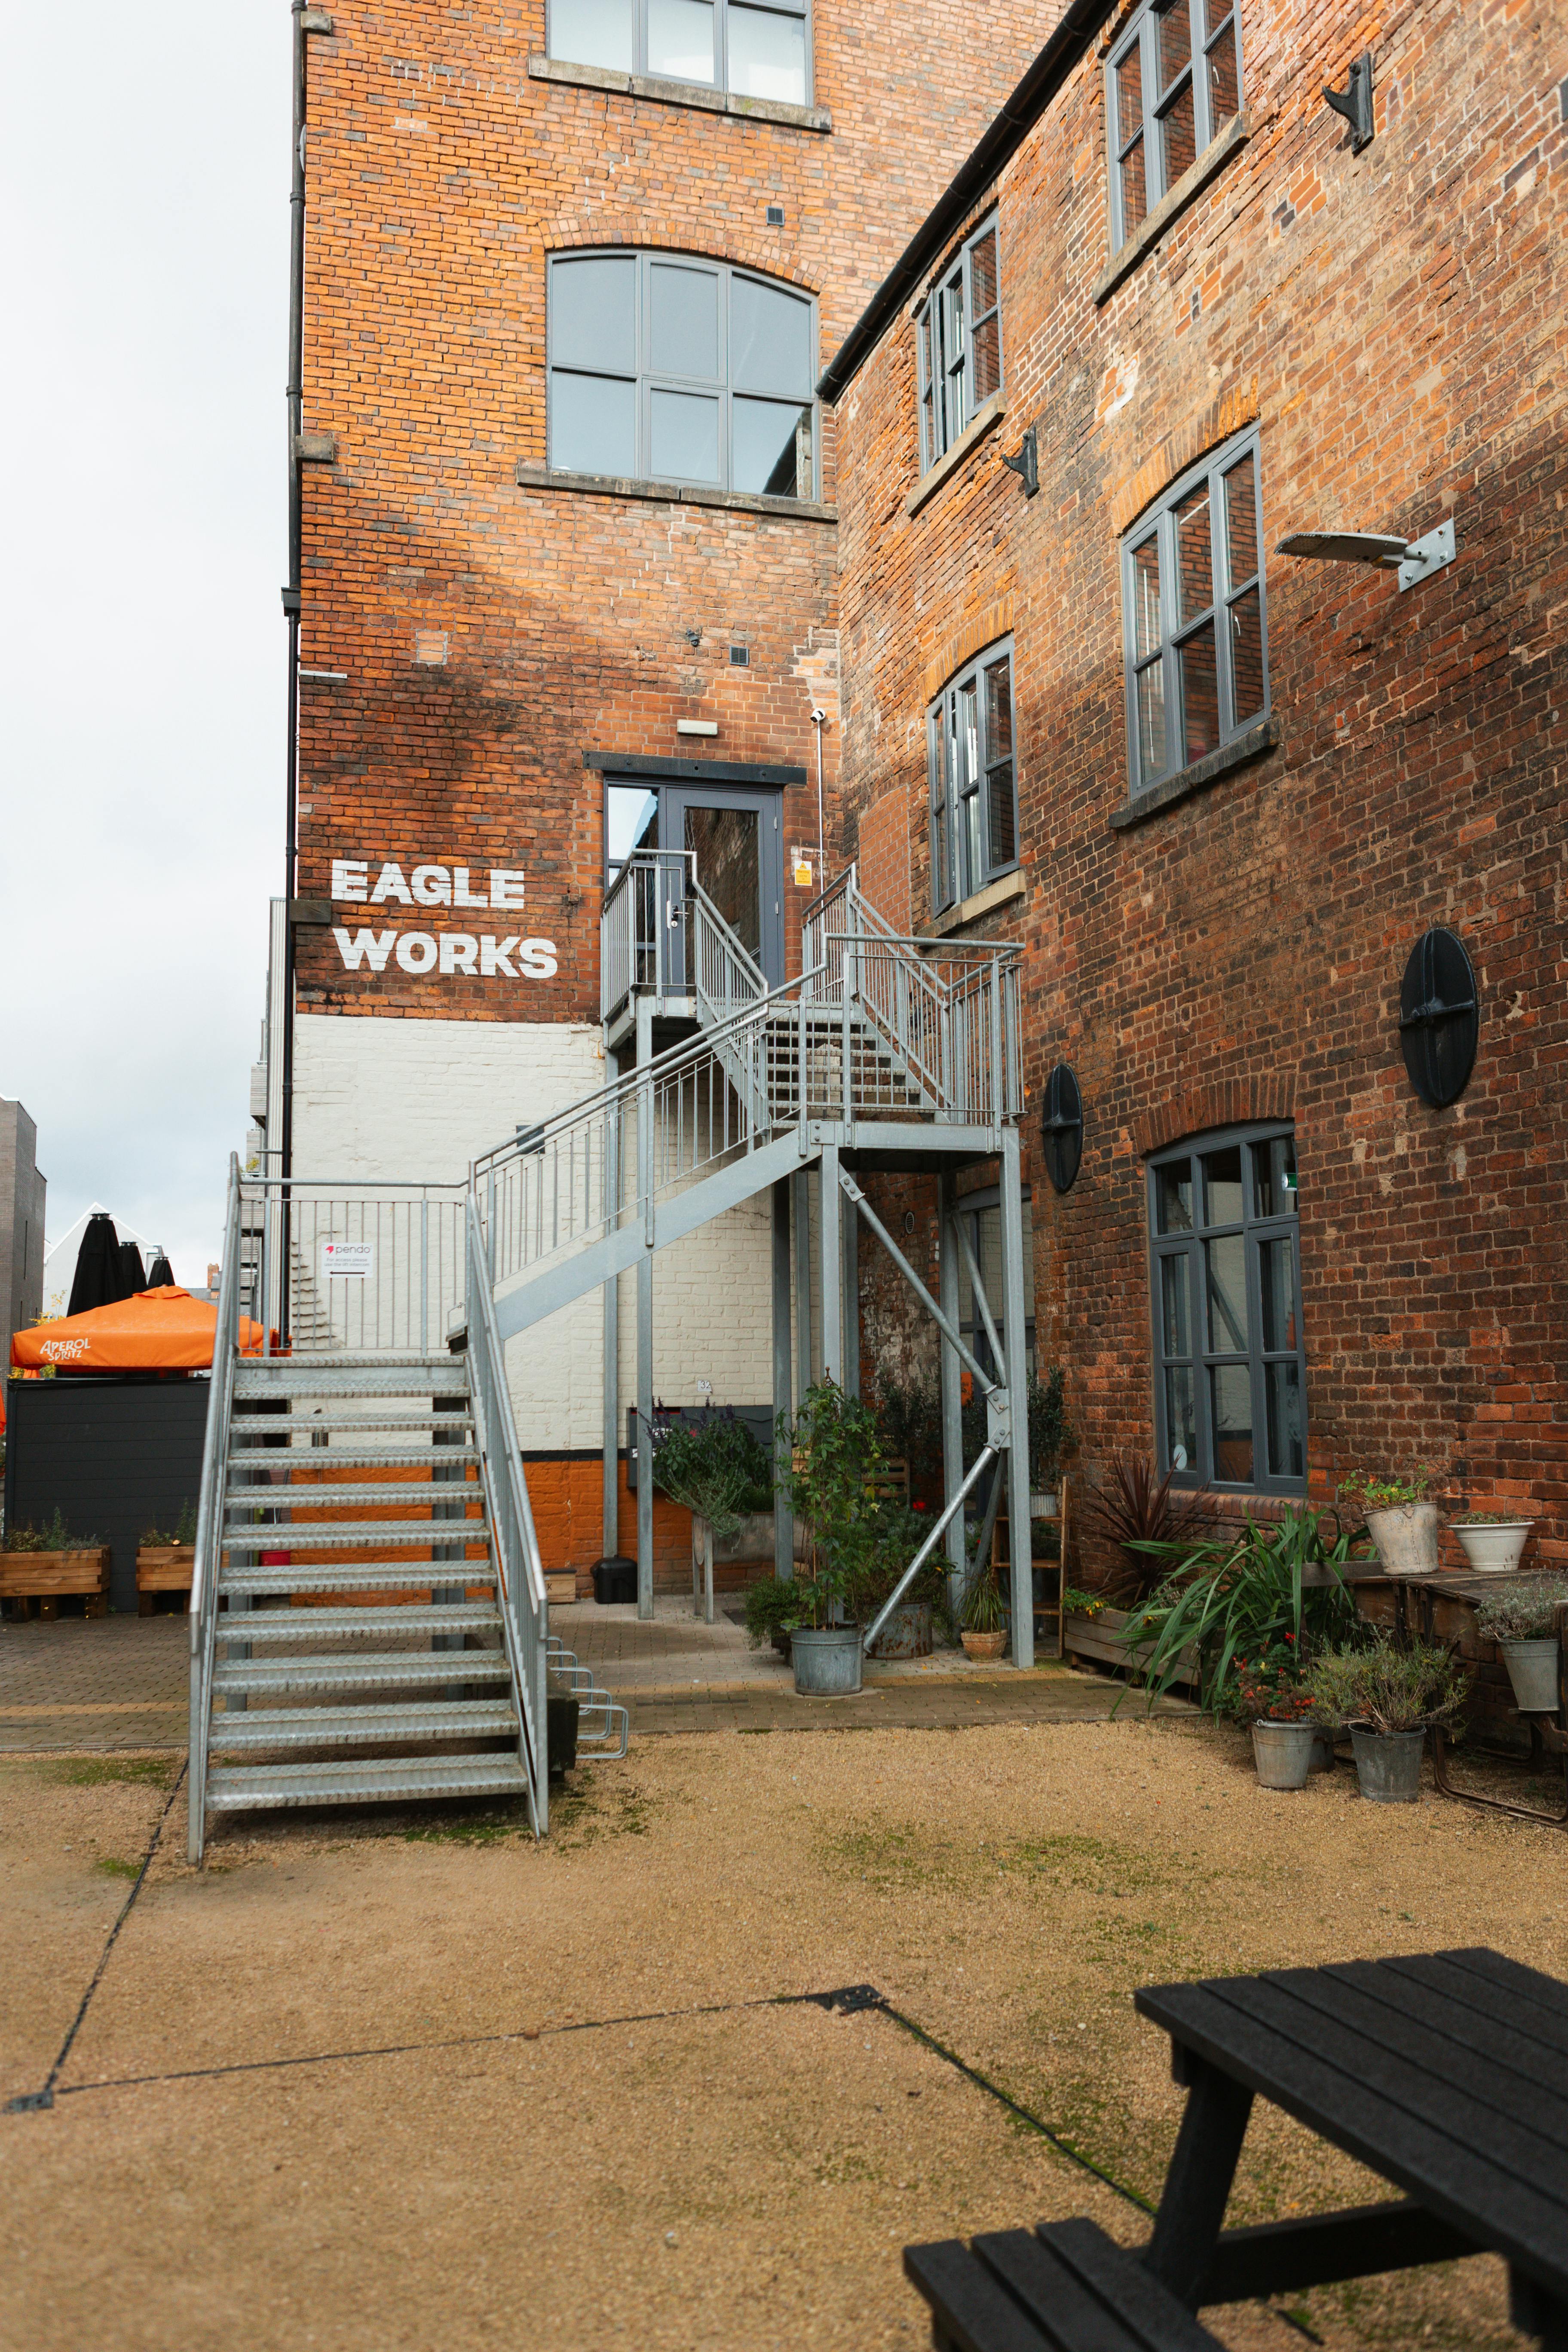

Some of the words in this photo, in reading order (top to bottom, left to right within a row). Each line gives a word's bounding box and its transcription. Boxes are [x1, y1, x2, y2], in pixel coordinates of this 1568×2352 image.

[331, 859, 524, 909] EAGLE
[332, 928, 557, 979] WORKS
[336, 1245, 371, 1255] pendo
[40, 1338, 91, 1354] APEROL
[701, 1380, 710, 1389] 32
